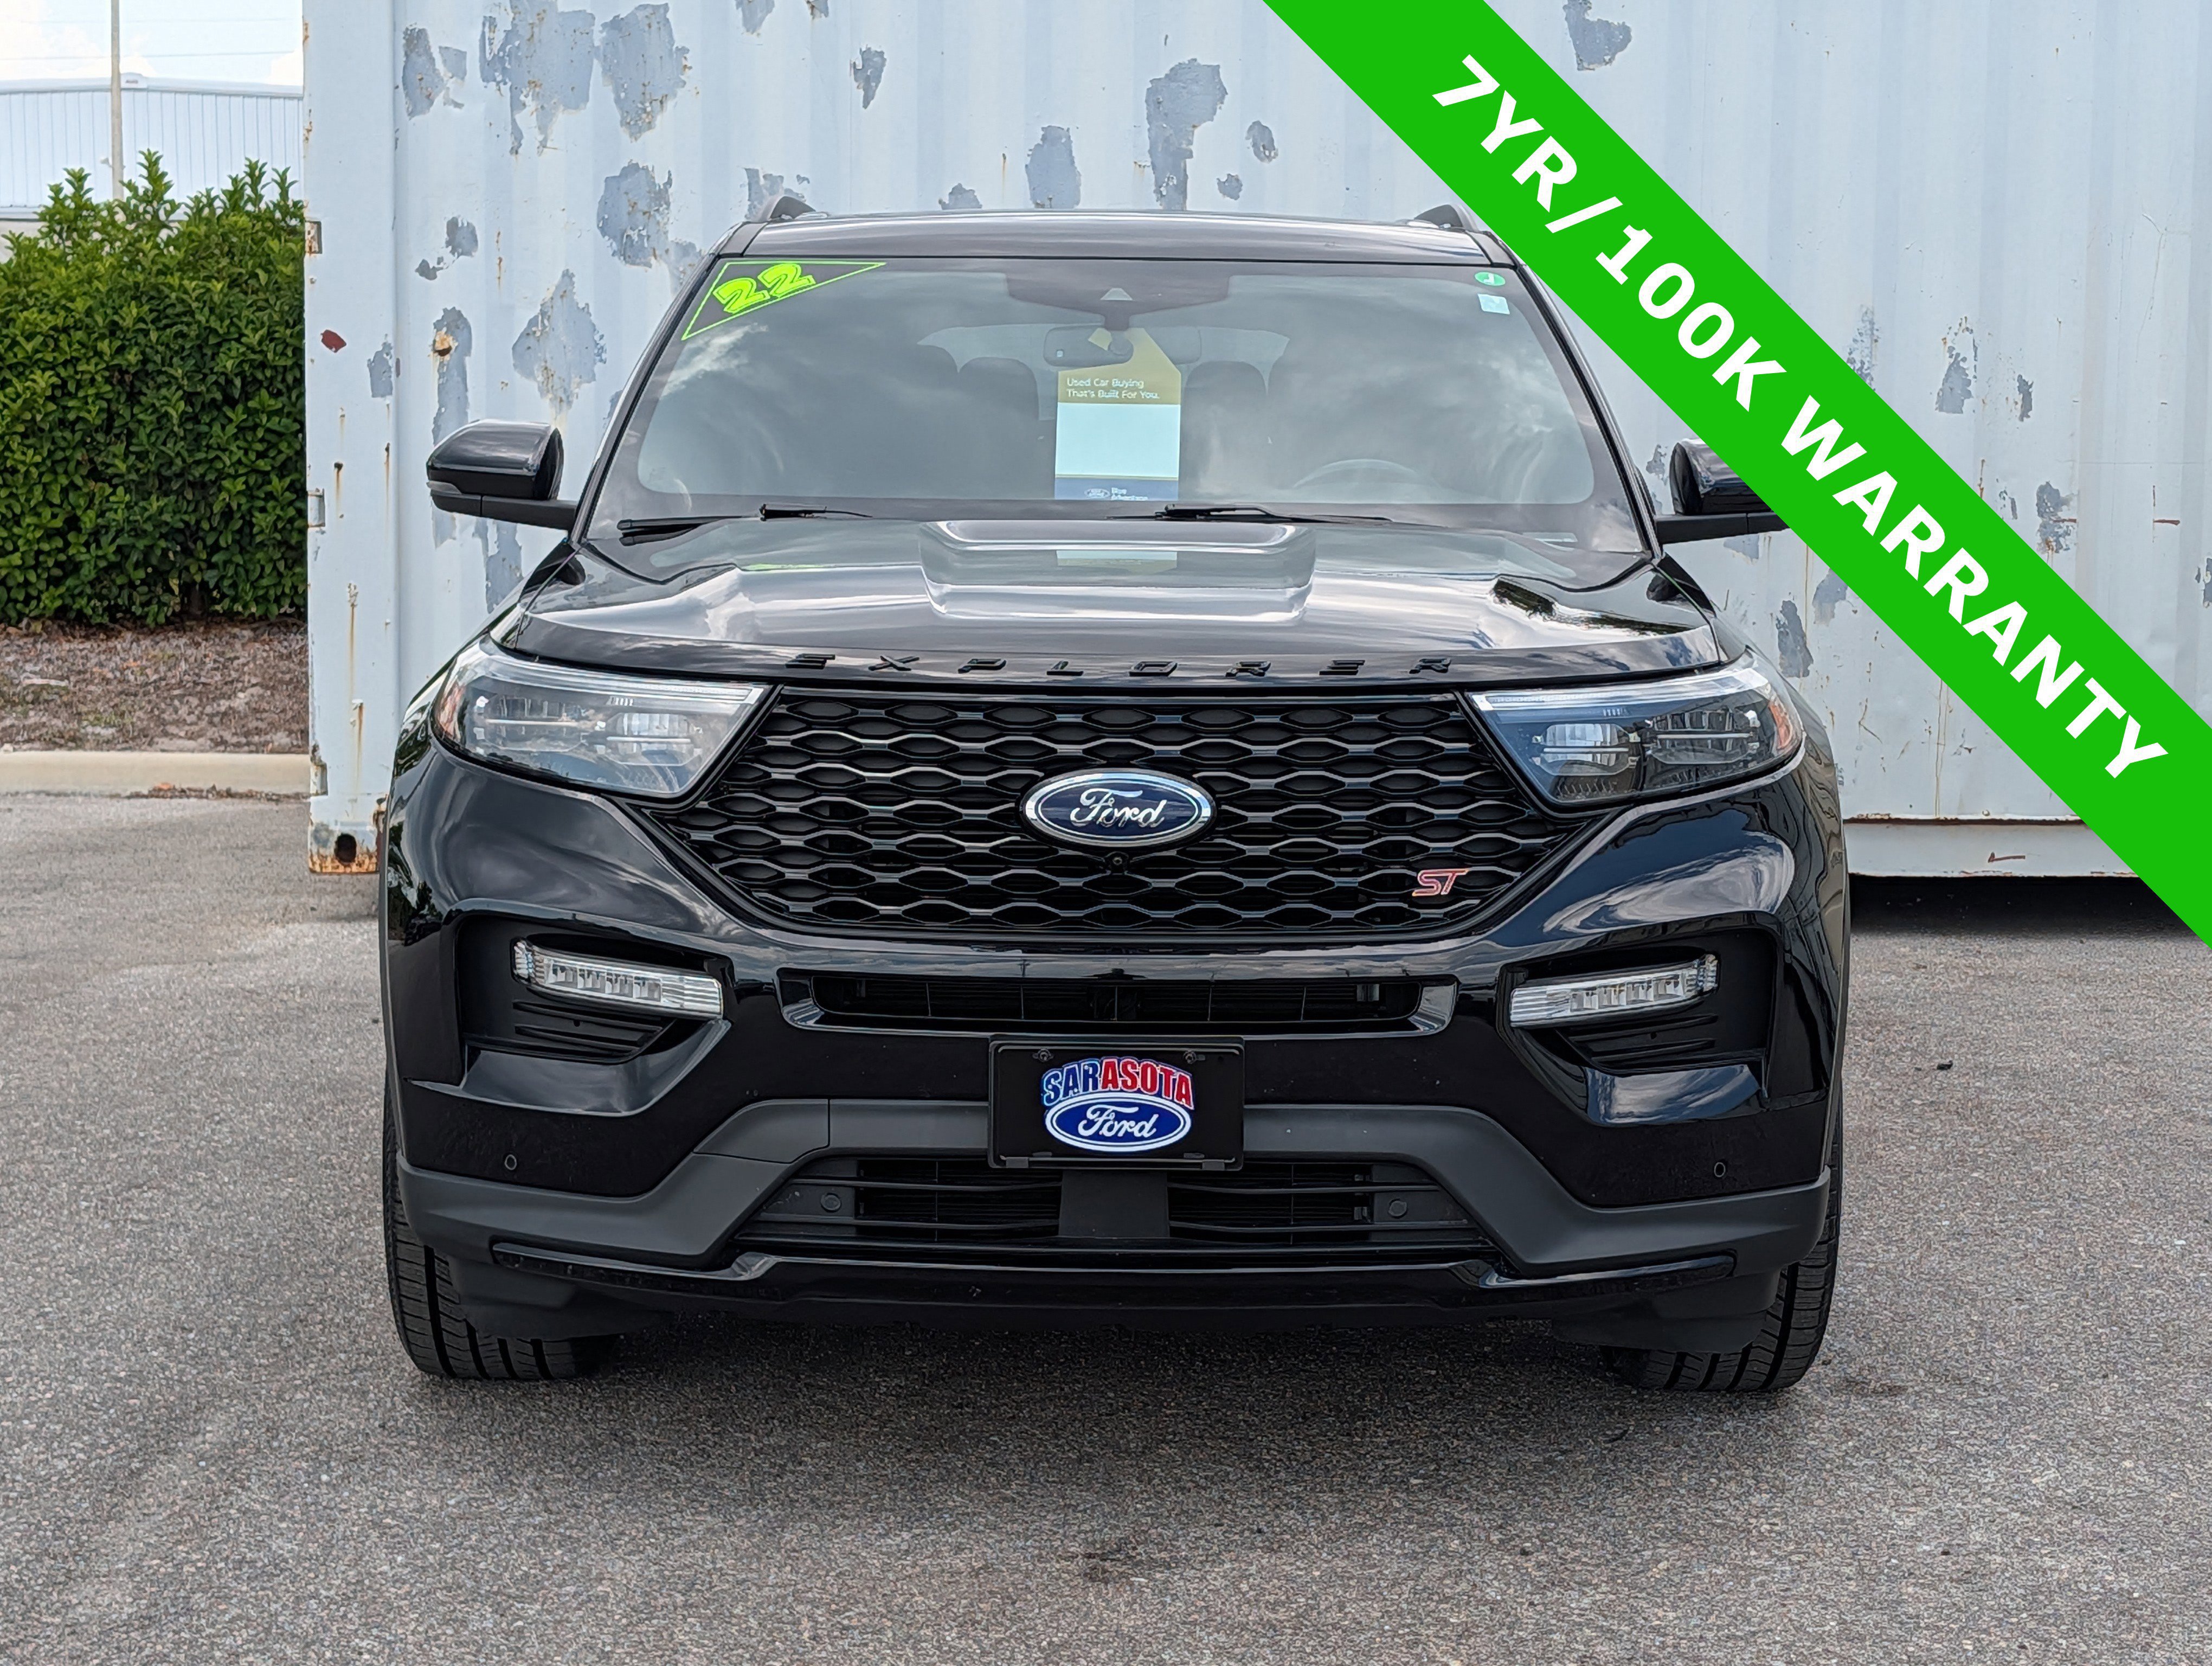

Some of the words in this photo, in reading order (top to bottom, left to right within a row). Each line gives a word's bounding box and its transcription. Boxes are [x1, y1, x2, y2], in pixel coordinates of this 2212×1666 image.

[712, 263, 816, 314] 22
[1066, 377, 1091, 387] Used
[1094, 378, 1109, 387] Car
[1111, 378, 1144, 389] Buying
[1122, 389, 1137, 399] For
[785, 653, 1452, 677] EXPLORER
[1070, 787, 1168, 829] Ford
[1412, 868, 1469, 896] ST
[1042, 1056, 1195, 1110] SARASOTA
[1077, 1104, 1160, 1138] Ford
